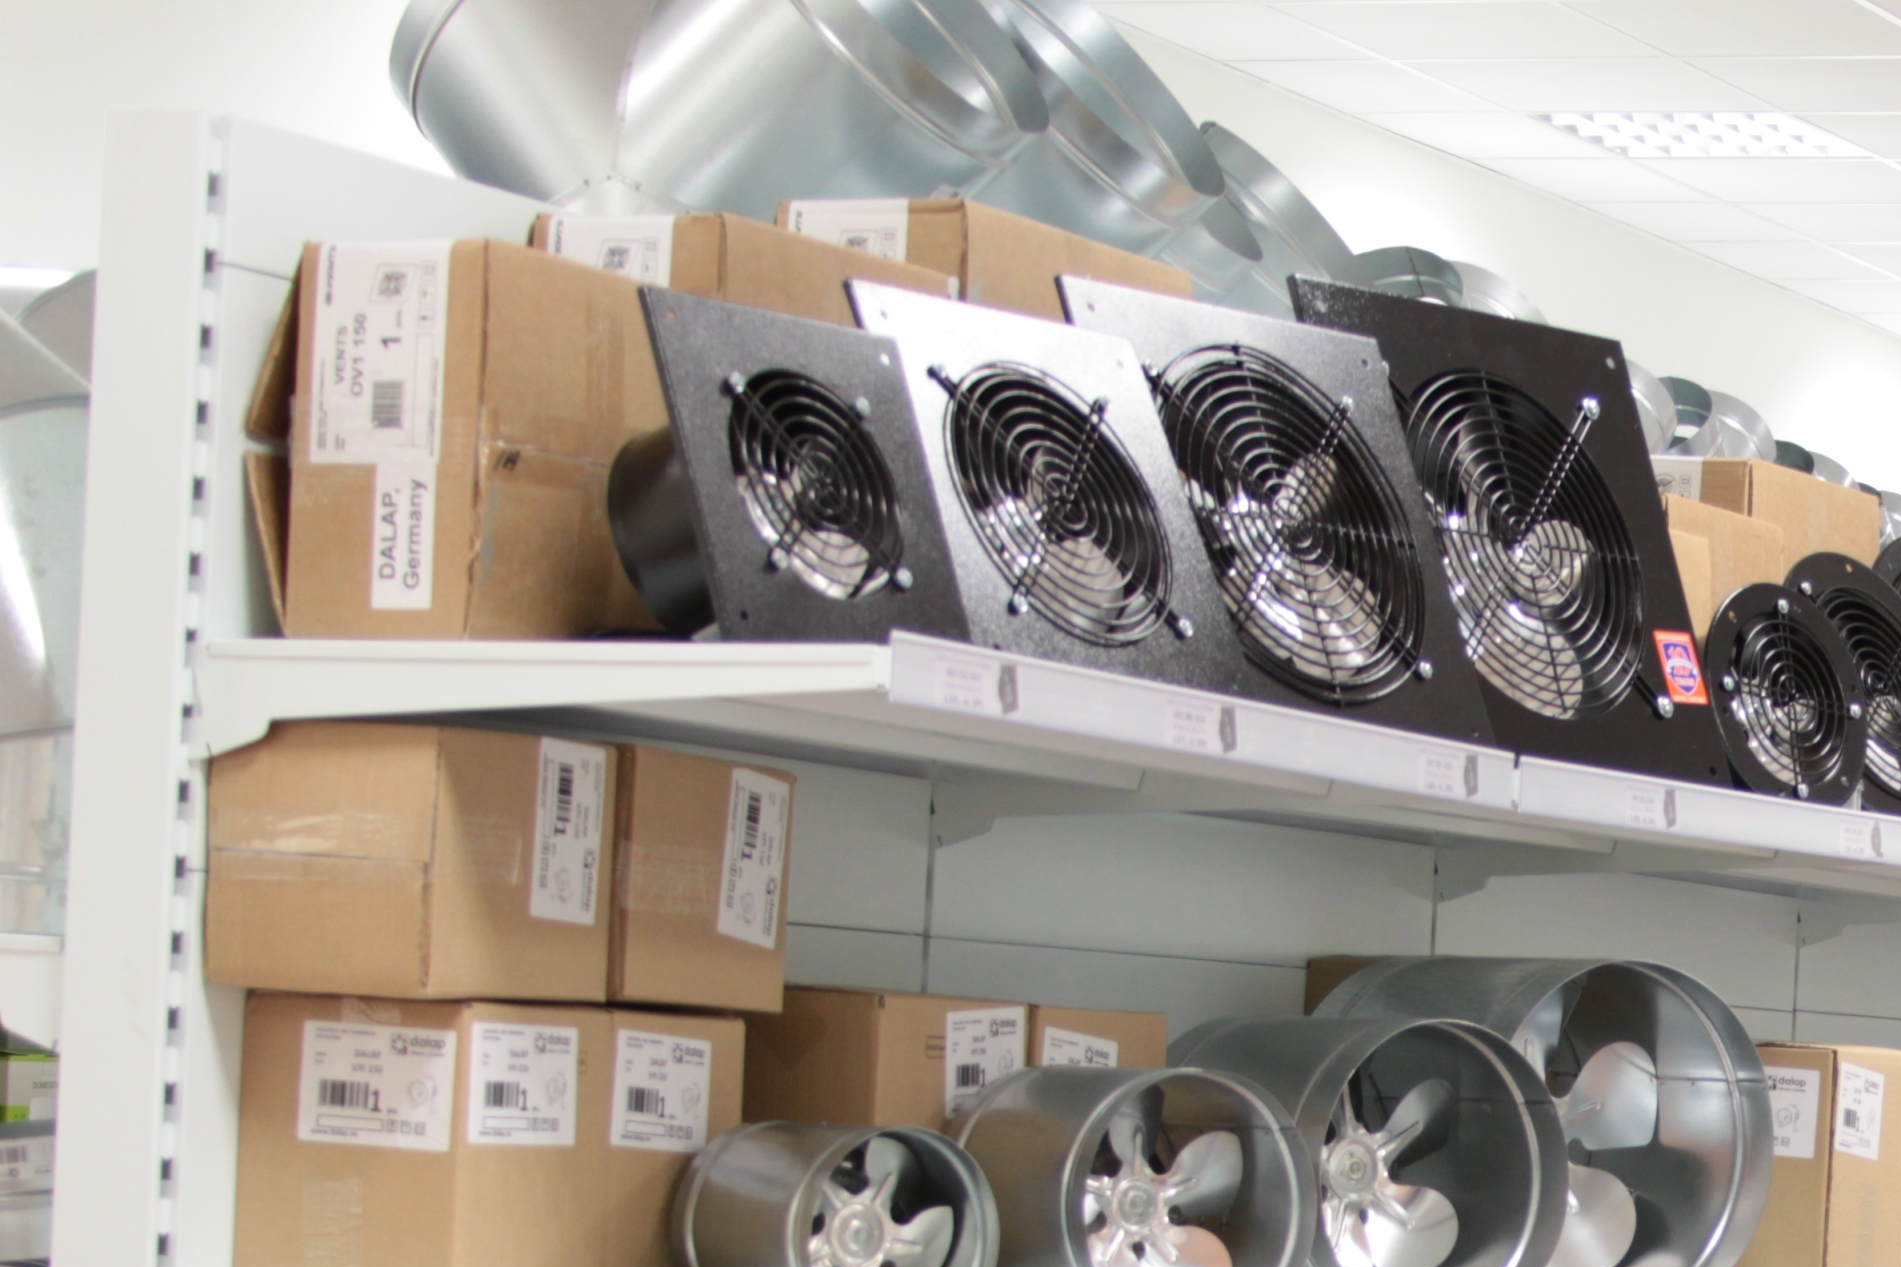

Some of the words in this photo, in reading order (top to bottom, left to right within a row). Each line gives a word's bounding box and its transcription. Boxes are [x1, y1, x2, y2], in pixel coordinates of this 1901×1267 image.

[353, 313, 367, 346] 150
[380, 336, 402, 349] 1
[335, 326, 348, 385] VENTS
[351, 357, 365, 397] OV1
[379, 487, 403, 580] DALAP,
[402, 478, 428, 589] Germany
[1778, 1076, 1807, 1087] dalap
[369, 1088, 382, 1112] 1
[520, 1088, 529, 1112] 1
[658, 1095, 667, 1119] 1
